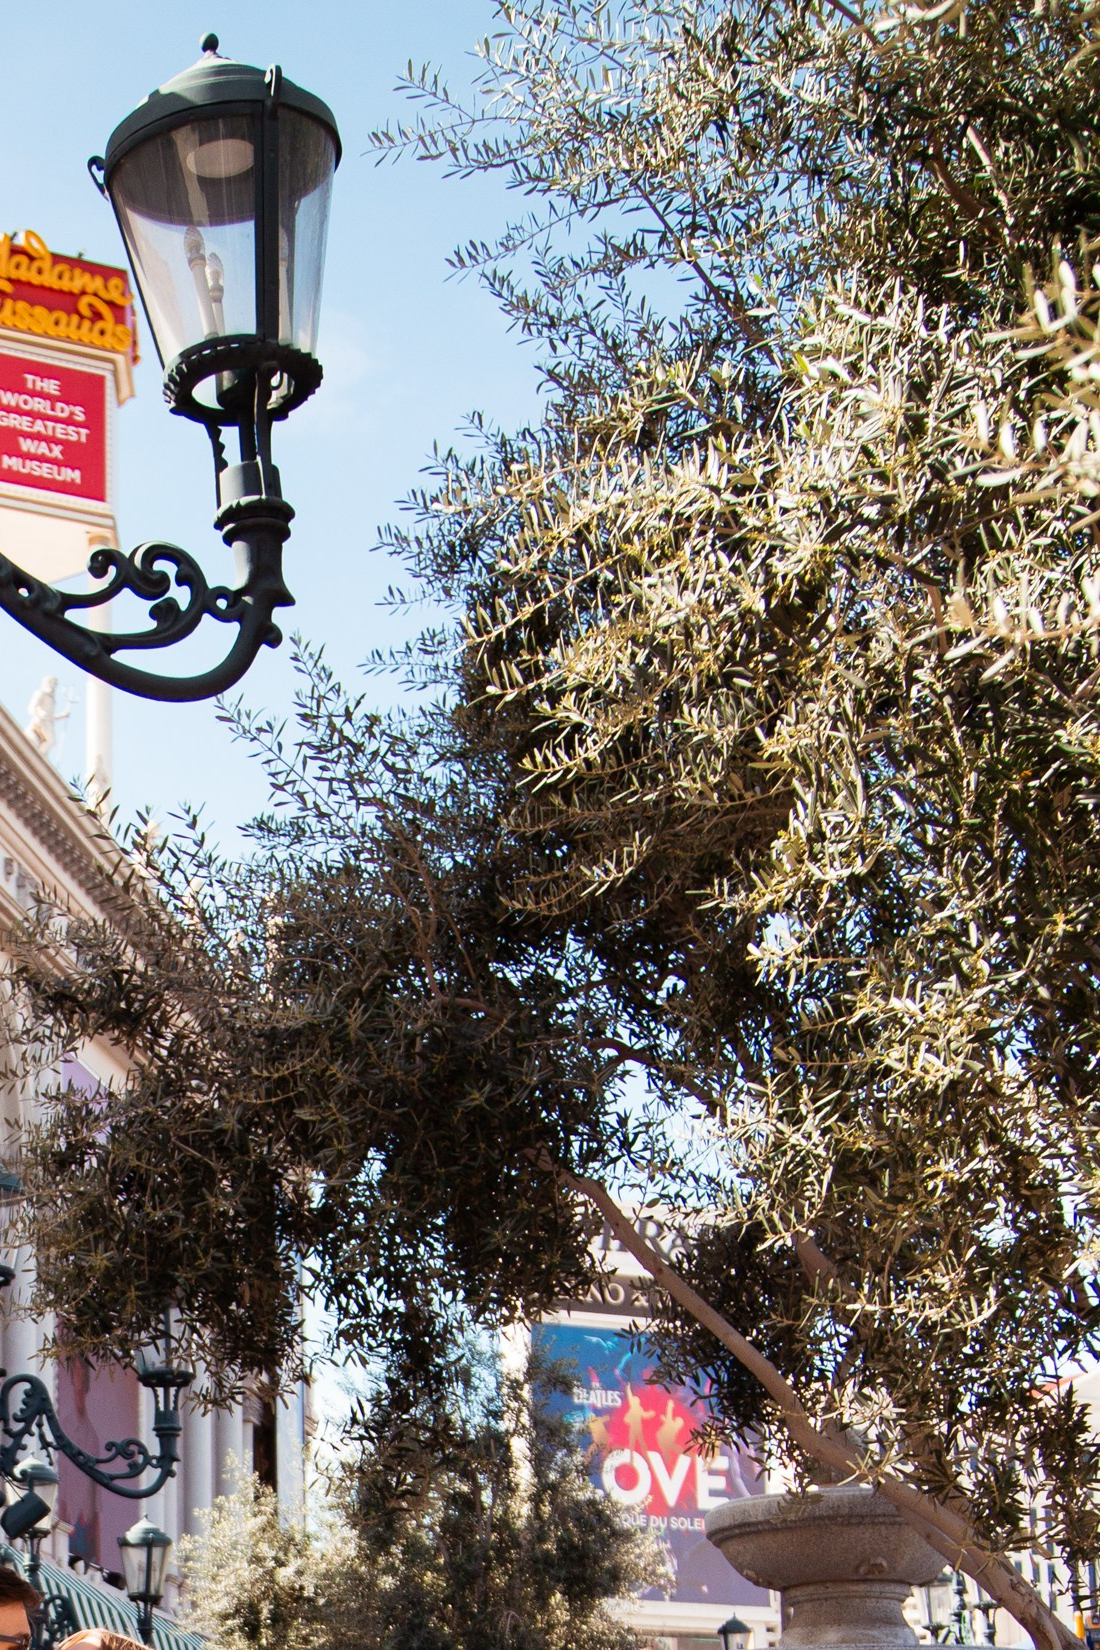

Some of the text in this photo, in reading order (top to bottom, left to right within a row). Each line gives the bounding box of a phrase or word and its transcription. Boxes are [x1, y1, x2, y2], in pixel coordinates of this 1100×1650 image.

[24, 373, 61, 396] THE
[18, 436, 64, 460] WAX
[1, 454, 82, 485] MUSEUM
[600, 1448, 730, 1511] OVE
[650, 1516, 667, 1529] DU
[670, 1516, 705, 1531] SOLEI
